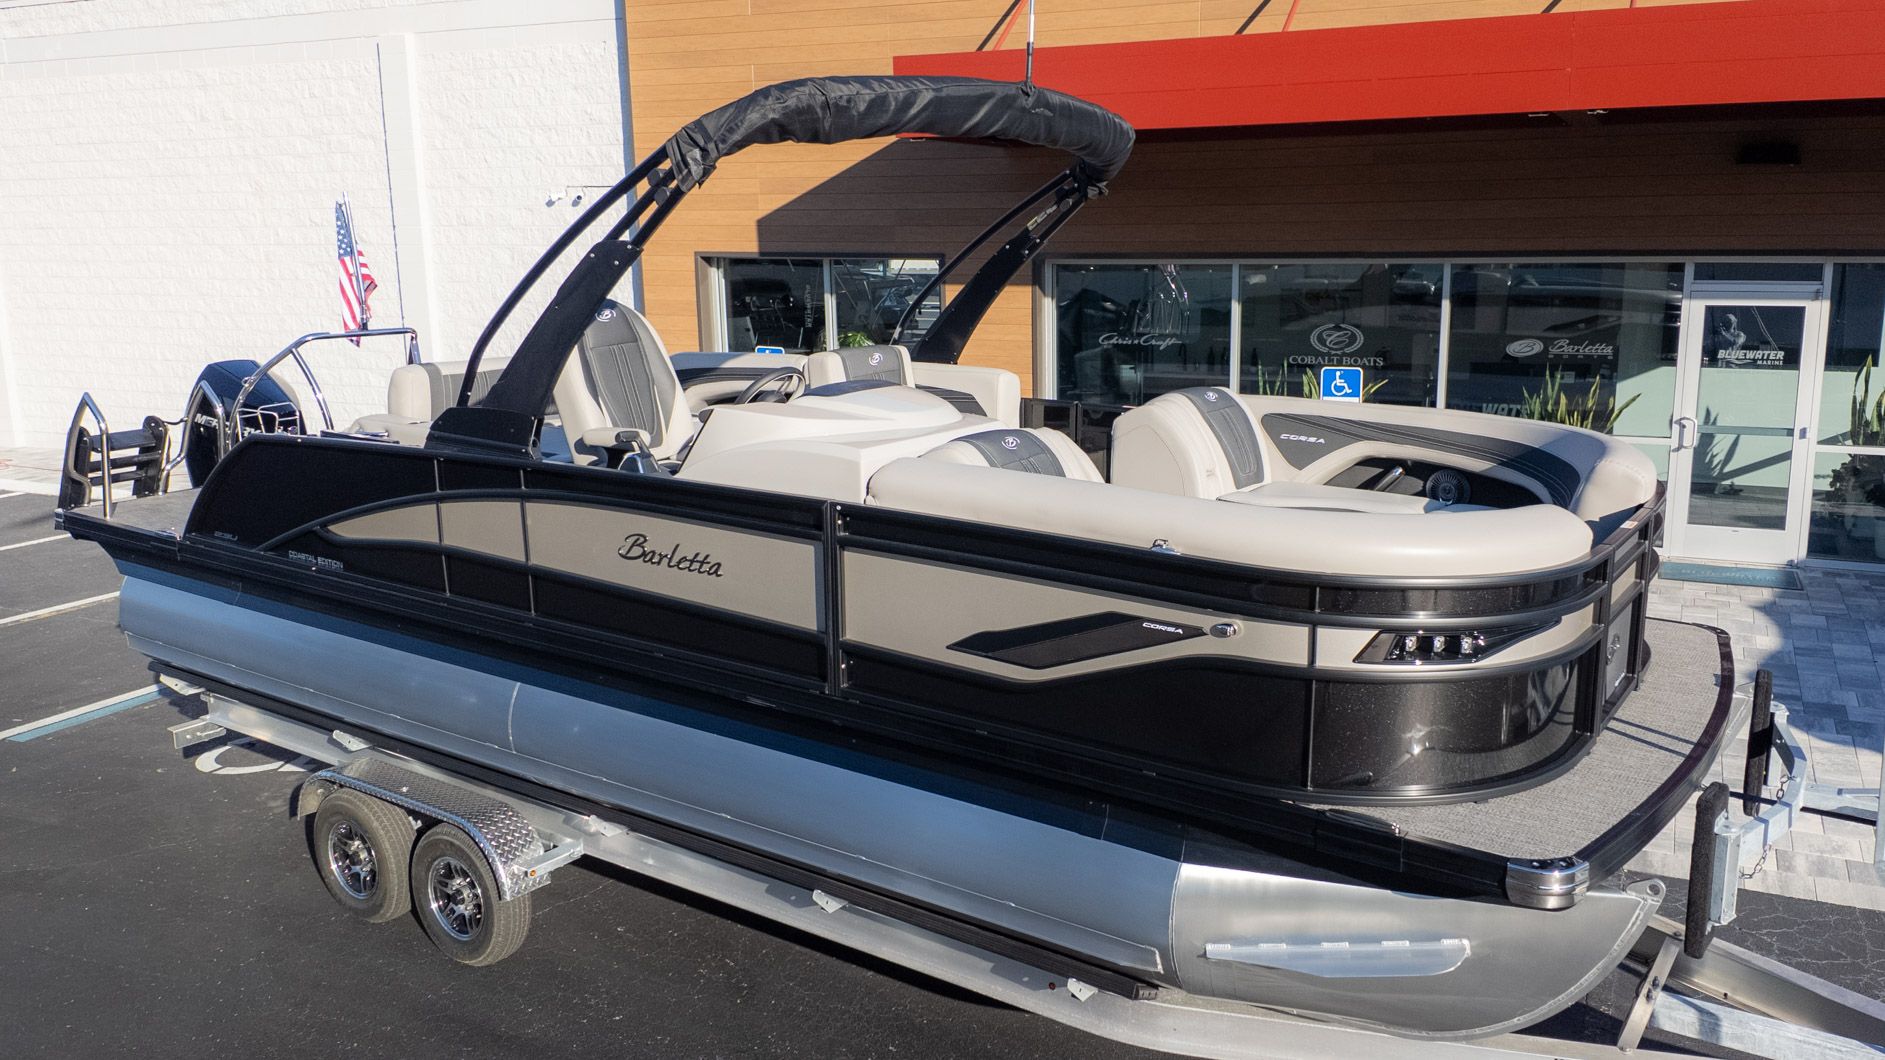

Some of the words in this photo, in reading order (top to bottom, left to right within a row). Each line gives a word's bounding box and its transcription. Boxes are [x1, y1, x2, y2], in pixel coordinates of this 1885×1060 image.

[1548, 339, 1614, 353] Barletta
[1717, 349, 1785, 360] BLUEWATER
[1289, 355, 1339, 365] COBALT
[1342, 356, 1384, 367] BOATS
[1280, 433, 1325, 444] CORSA
[288, 550, 317, 563] COASTAL
[317, 556, 344, 569] EDITION
[618, 533, 723, 577] Barletta
[1142, 622, 1183, 634] CORSA
